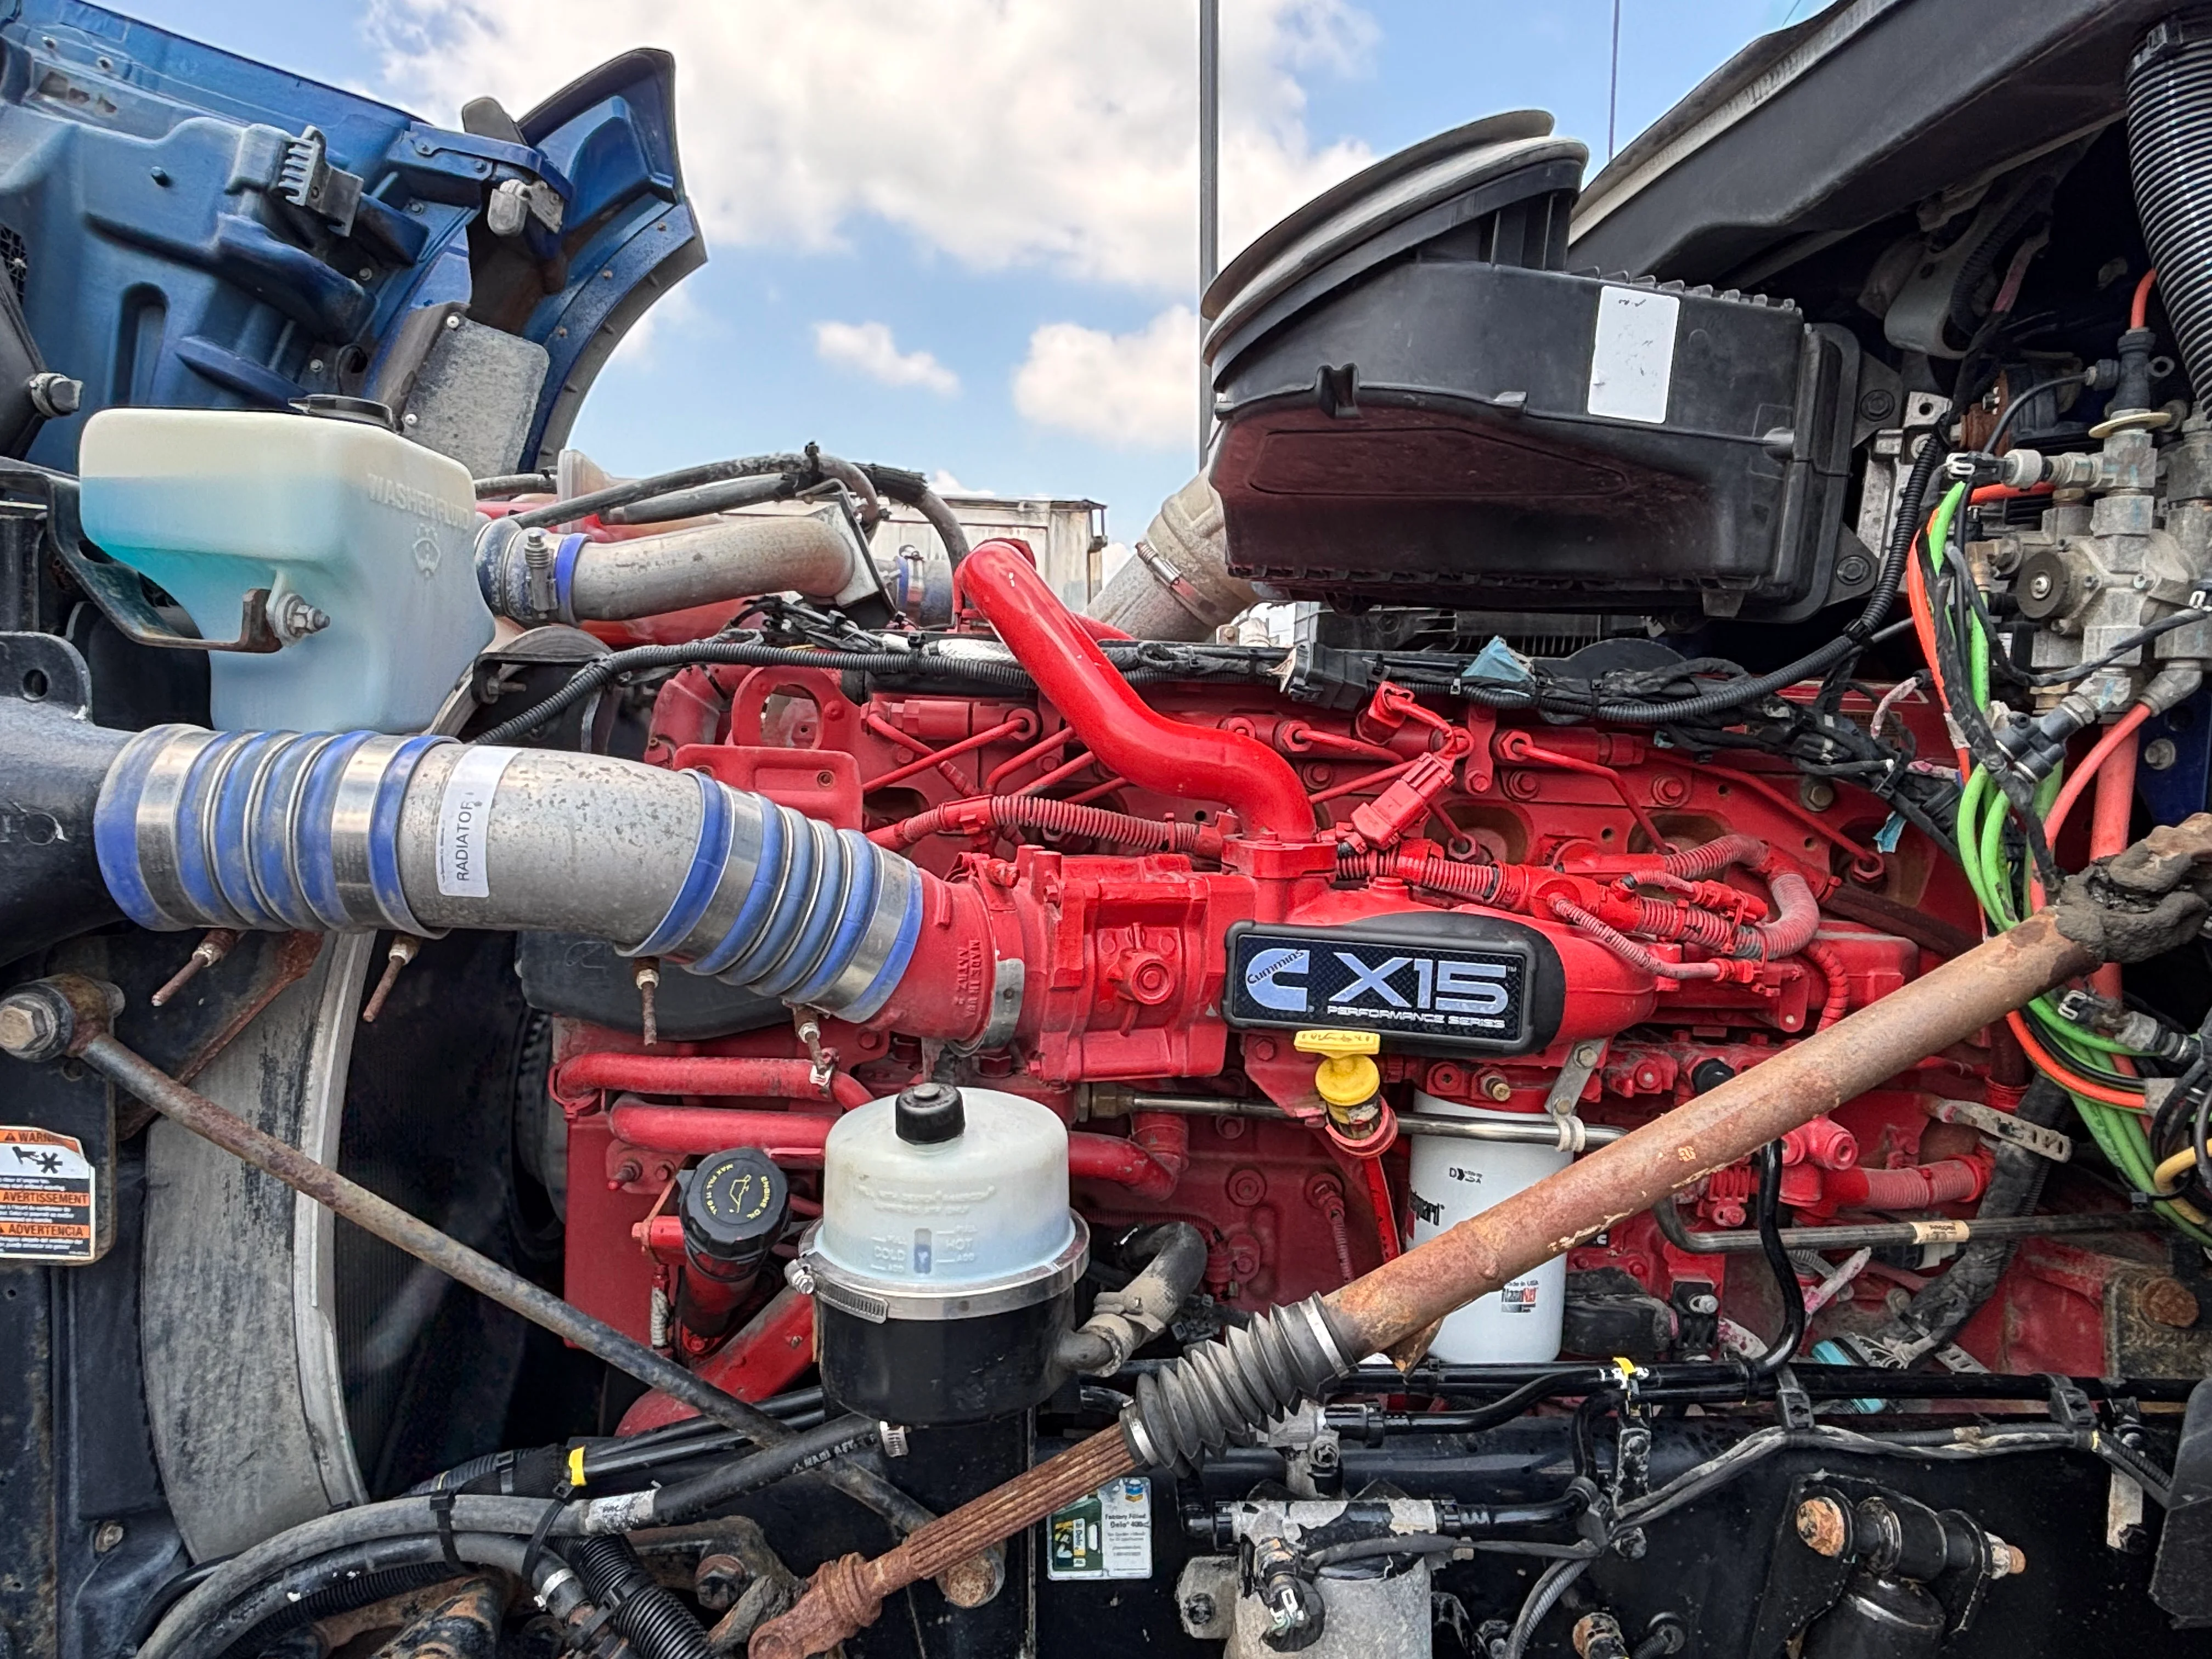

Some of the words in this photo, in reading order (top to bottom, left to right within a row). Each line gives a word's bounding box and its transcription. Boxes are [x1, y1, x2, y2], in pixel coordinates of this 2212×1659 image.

[1248, 950, 1304, 984] Cummins
[1329, 951, 1509, 1015] X15
[1327, 1005, 1445, 1024] PERFORMANCE
[1448, 1016, 1505, 1029] SERIES
[3, 1192, 88, 1204] AVERTISSEMENT
[8, 1224, 83, 1236] ADVERTENCIA
[946, 1237, 974, 1251] HOT
[874, 1245, 906, 1262] COLD
